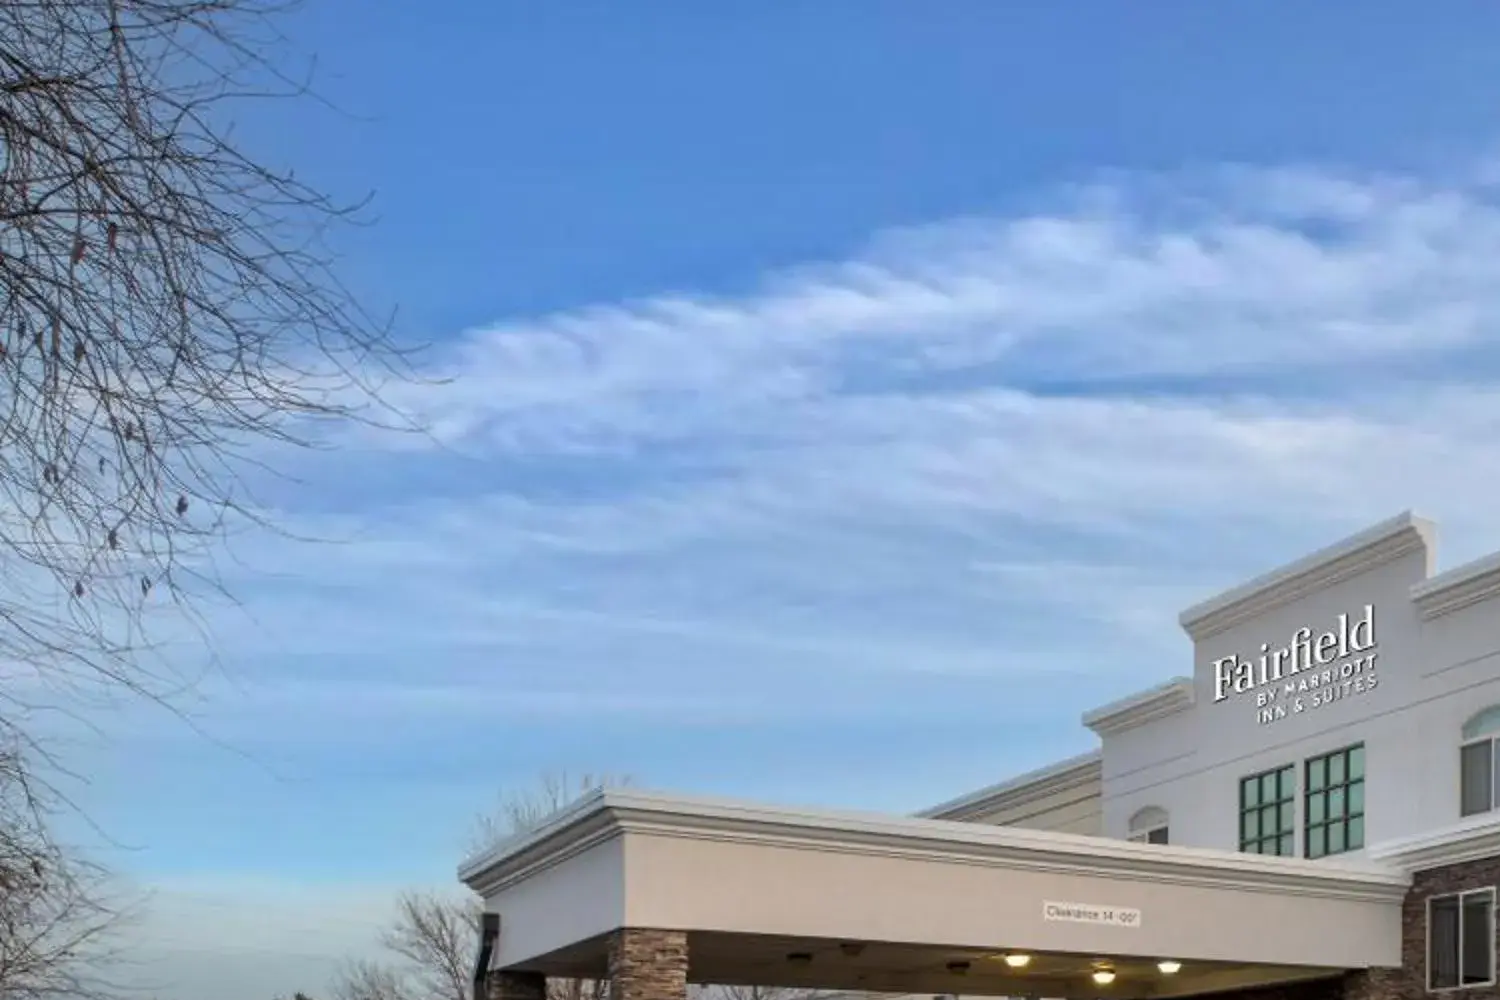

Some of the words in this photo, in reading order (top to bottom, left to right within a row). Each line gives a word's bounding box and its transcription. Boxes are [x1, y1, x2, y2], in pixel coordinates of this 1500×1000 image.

[1212, 604, 1376, 702] Fairfield
[1256, 687, 1279, 707] BY
[1284, 653, 1377, 693] MARRIOTT
[1256, 704, 1288, 724] INN
[1293, 700, 1305, 713] &
[1312, 673, 1377, 707] SUITES
